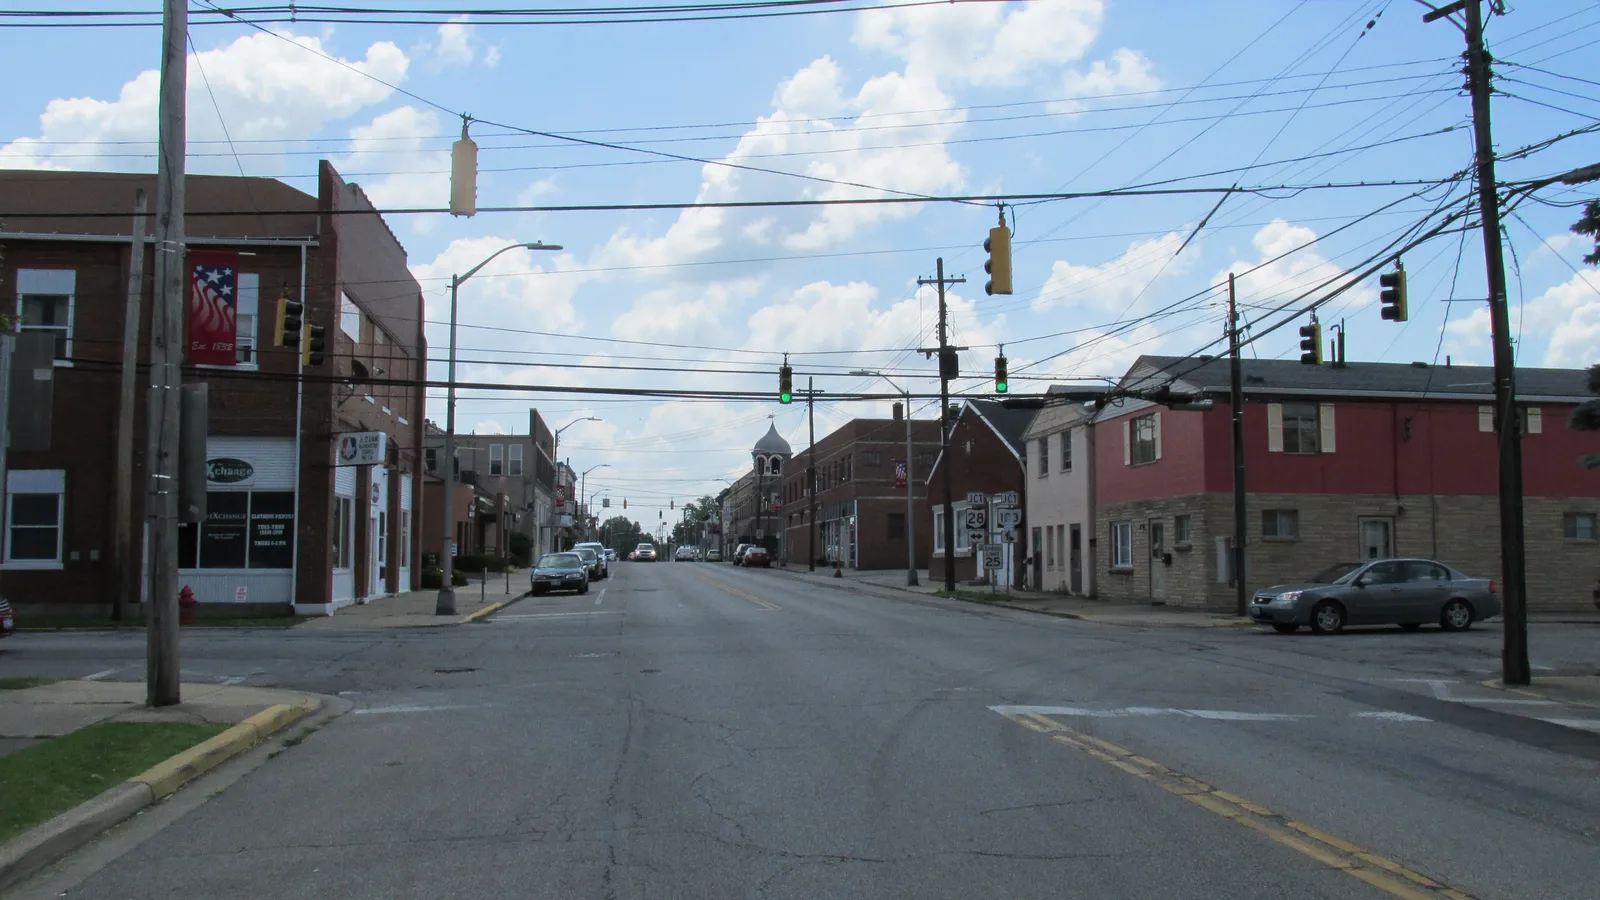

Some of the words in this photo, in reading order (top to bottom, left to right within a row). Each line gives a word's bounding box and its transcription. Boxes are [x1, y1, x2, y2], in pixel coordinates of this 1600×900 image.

[968, 494, 983, 503] JCT
[1003, 494, 1017, 503] JCT
[968, 513, 984, 524] 28
[985, 557, 1001, 567] 25
